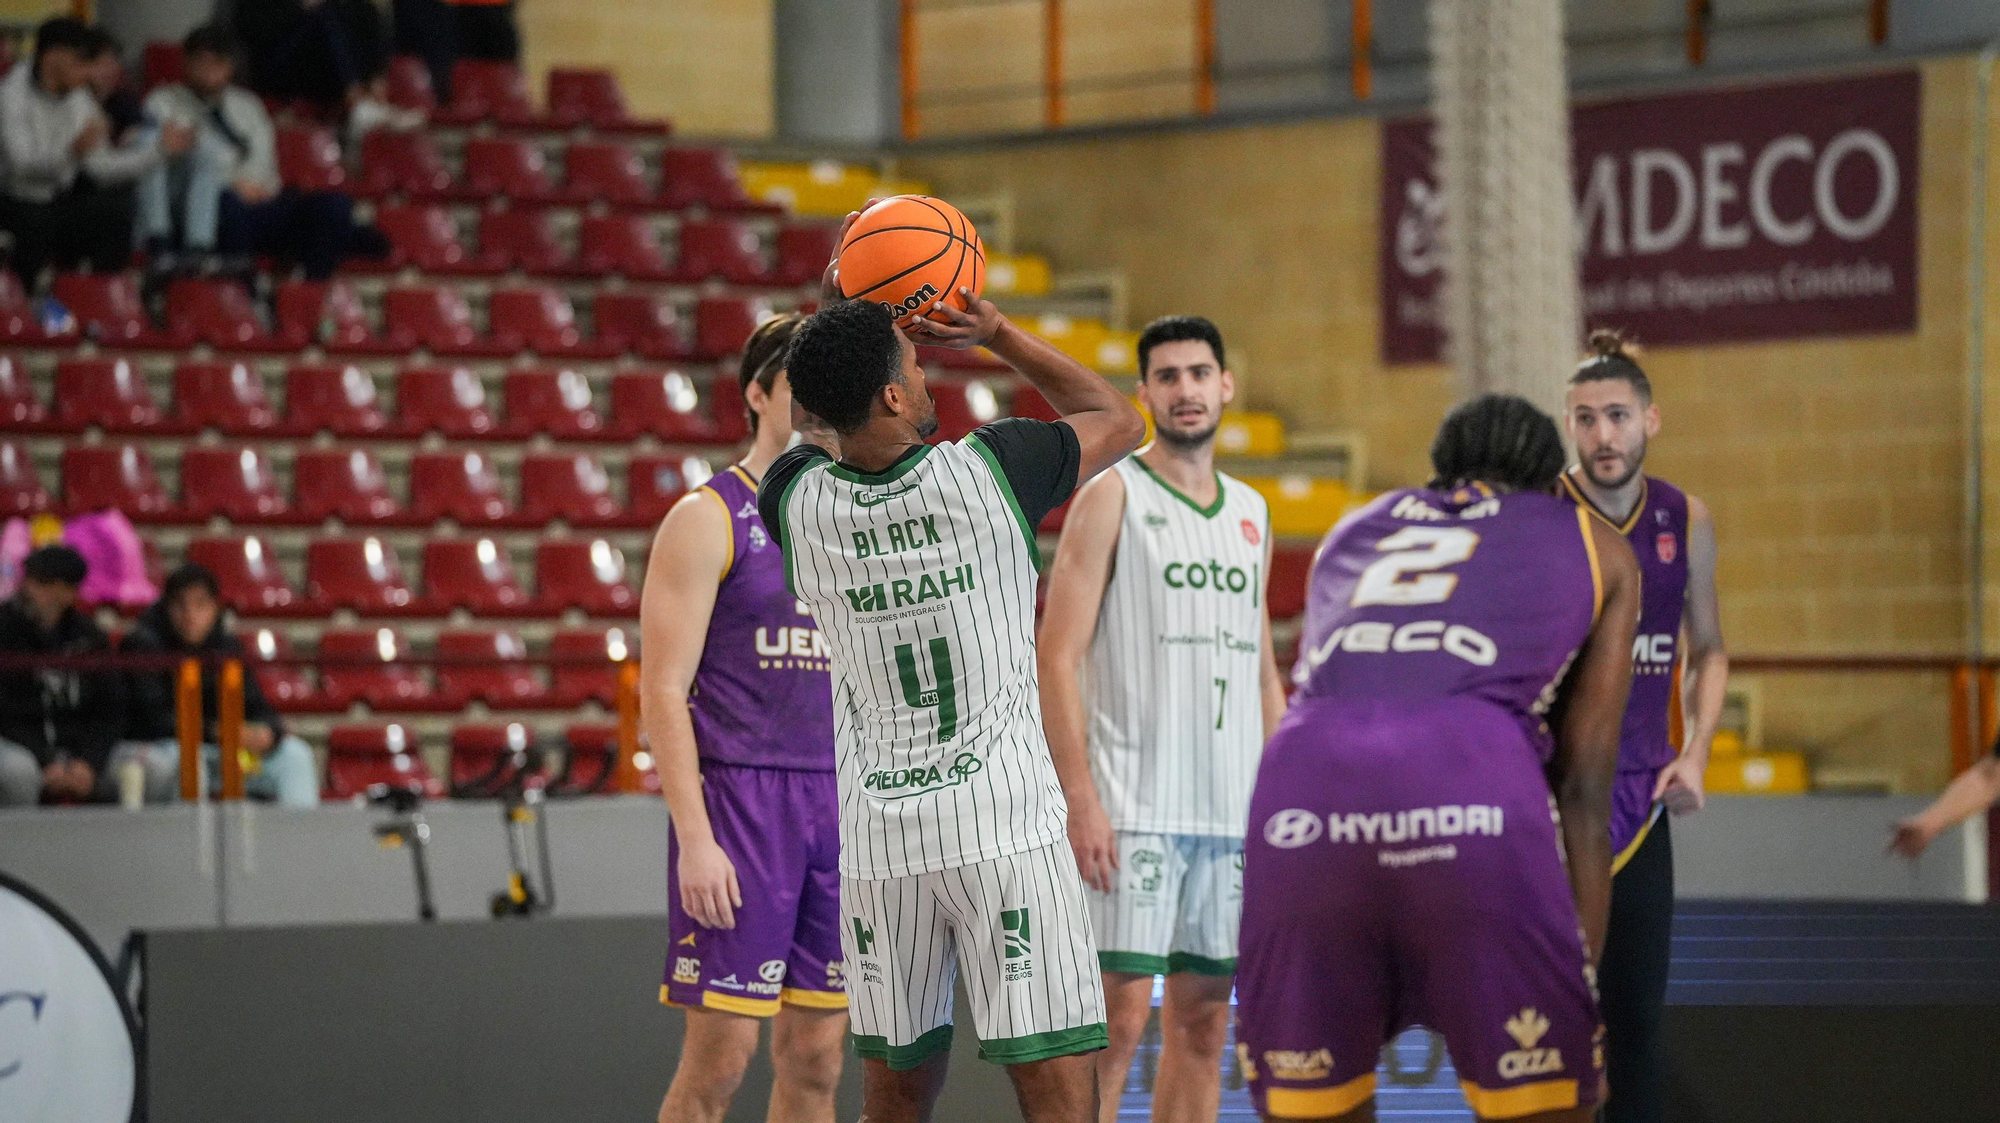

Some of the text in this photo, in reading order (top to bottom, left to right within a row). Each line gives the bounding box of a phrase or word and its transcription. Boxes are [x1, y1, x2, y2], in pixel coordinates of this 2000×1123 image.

[852, 514, 942, 560] BLACK
[892, 563, 976, 607] RAHI
[1164, 559, 1247, 593] coto
[1351, 526, 1481, 607] 2
[855, 603, 947, 624] SOLUCIONES INTEGRALES
[894, 636, 957, 745] 4
[920, 691, 940, 706] CCB
[1214, 677, 1227, 730] 7
[1328, 804, 1504, 843] HYUNDAI
[1005, 960, 1032, 973] RELE
